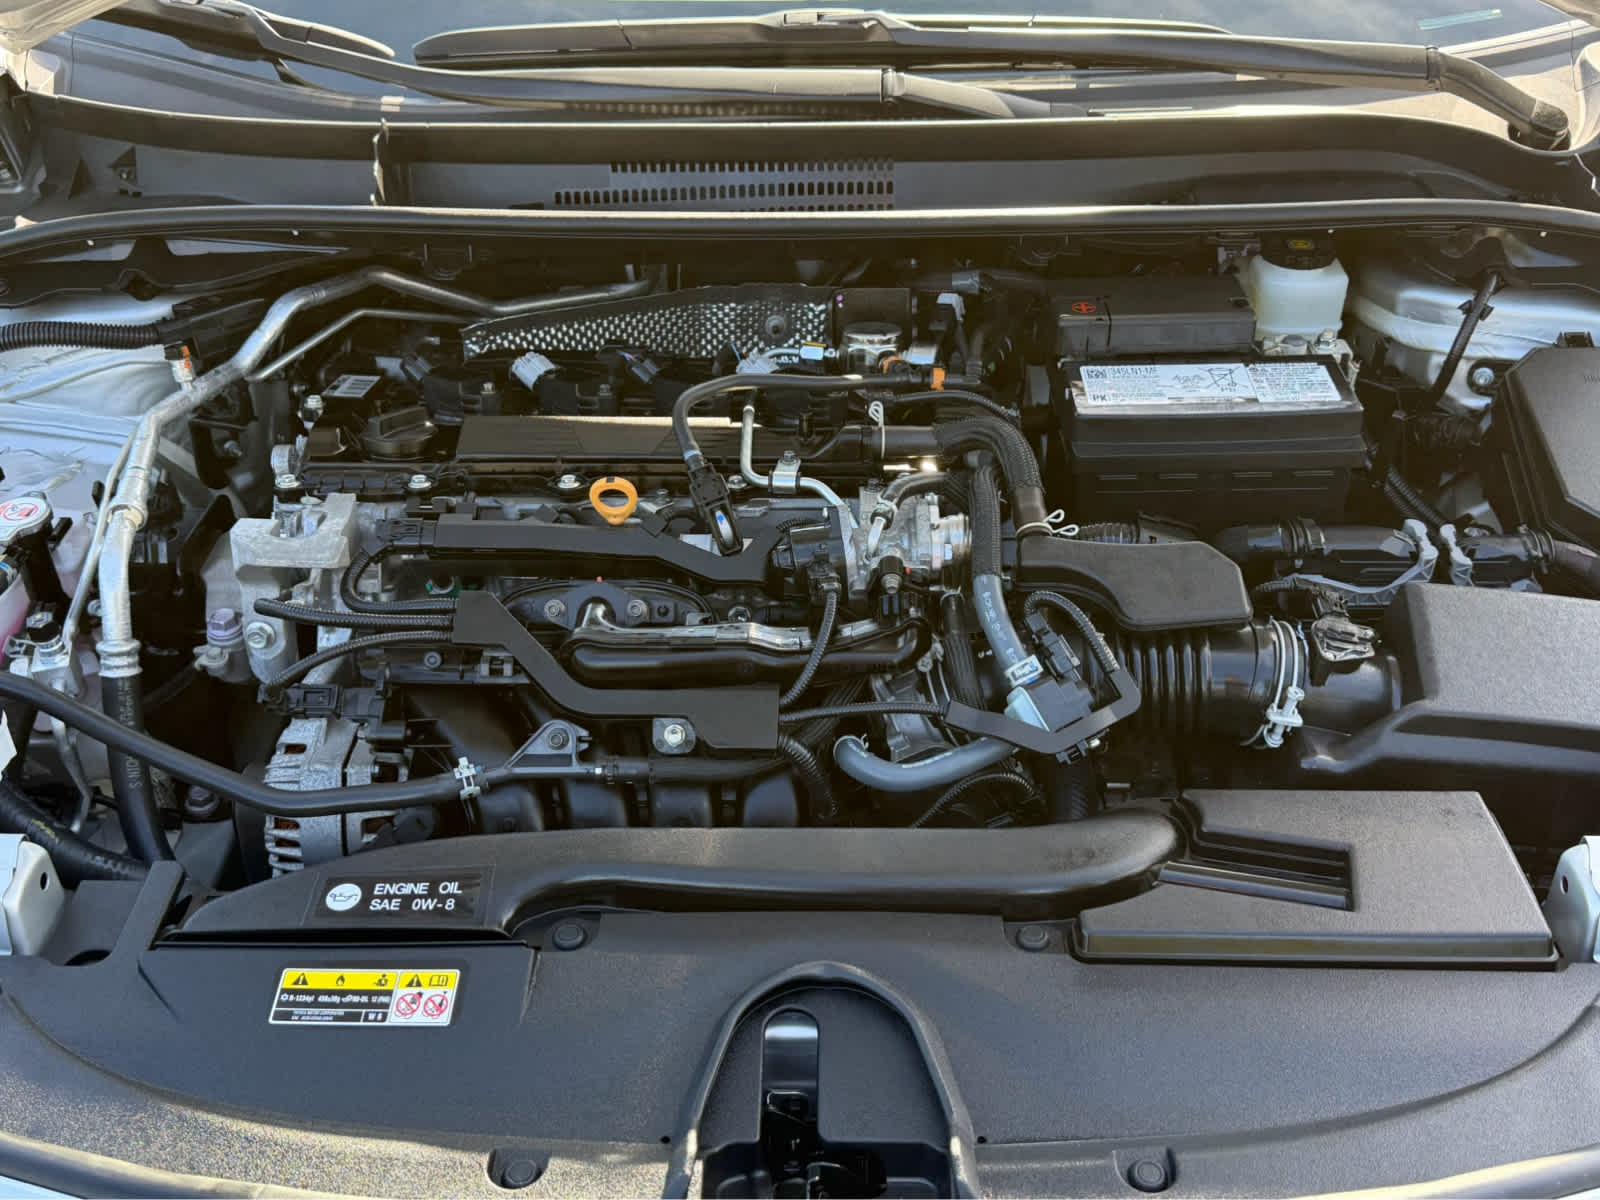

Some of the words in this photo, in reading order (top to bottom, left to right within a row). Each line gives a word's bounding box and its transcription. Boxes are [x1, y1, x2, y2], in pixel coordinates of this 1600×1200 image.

[373, 882, 430, 895] ENGINE
[438, 881, 463, 894] OIL
[369, 898, 401, 911] SAE
[411, 898, 455, 911] 0W-8
